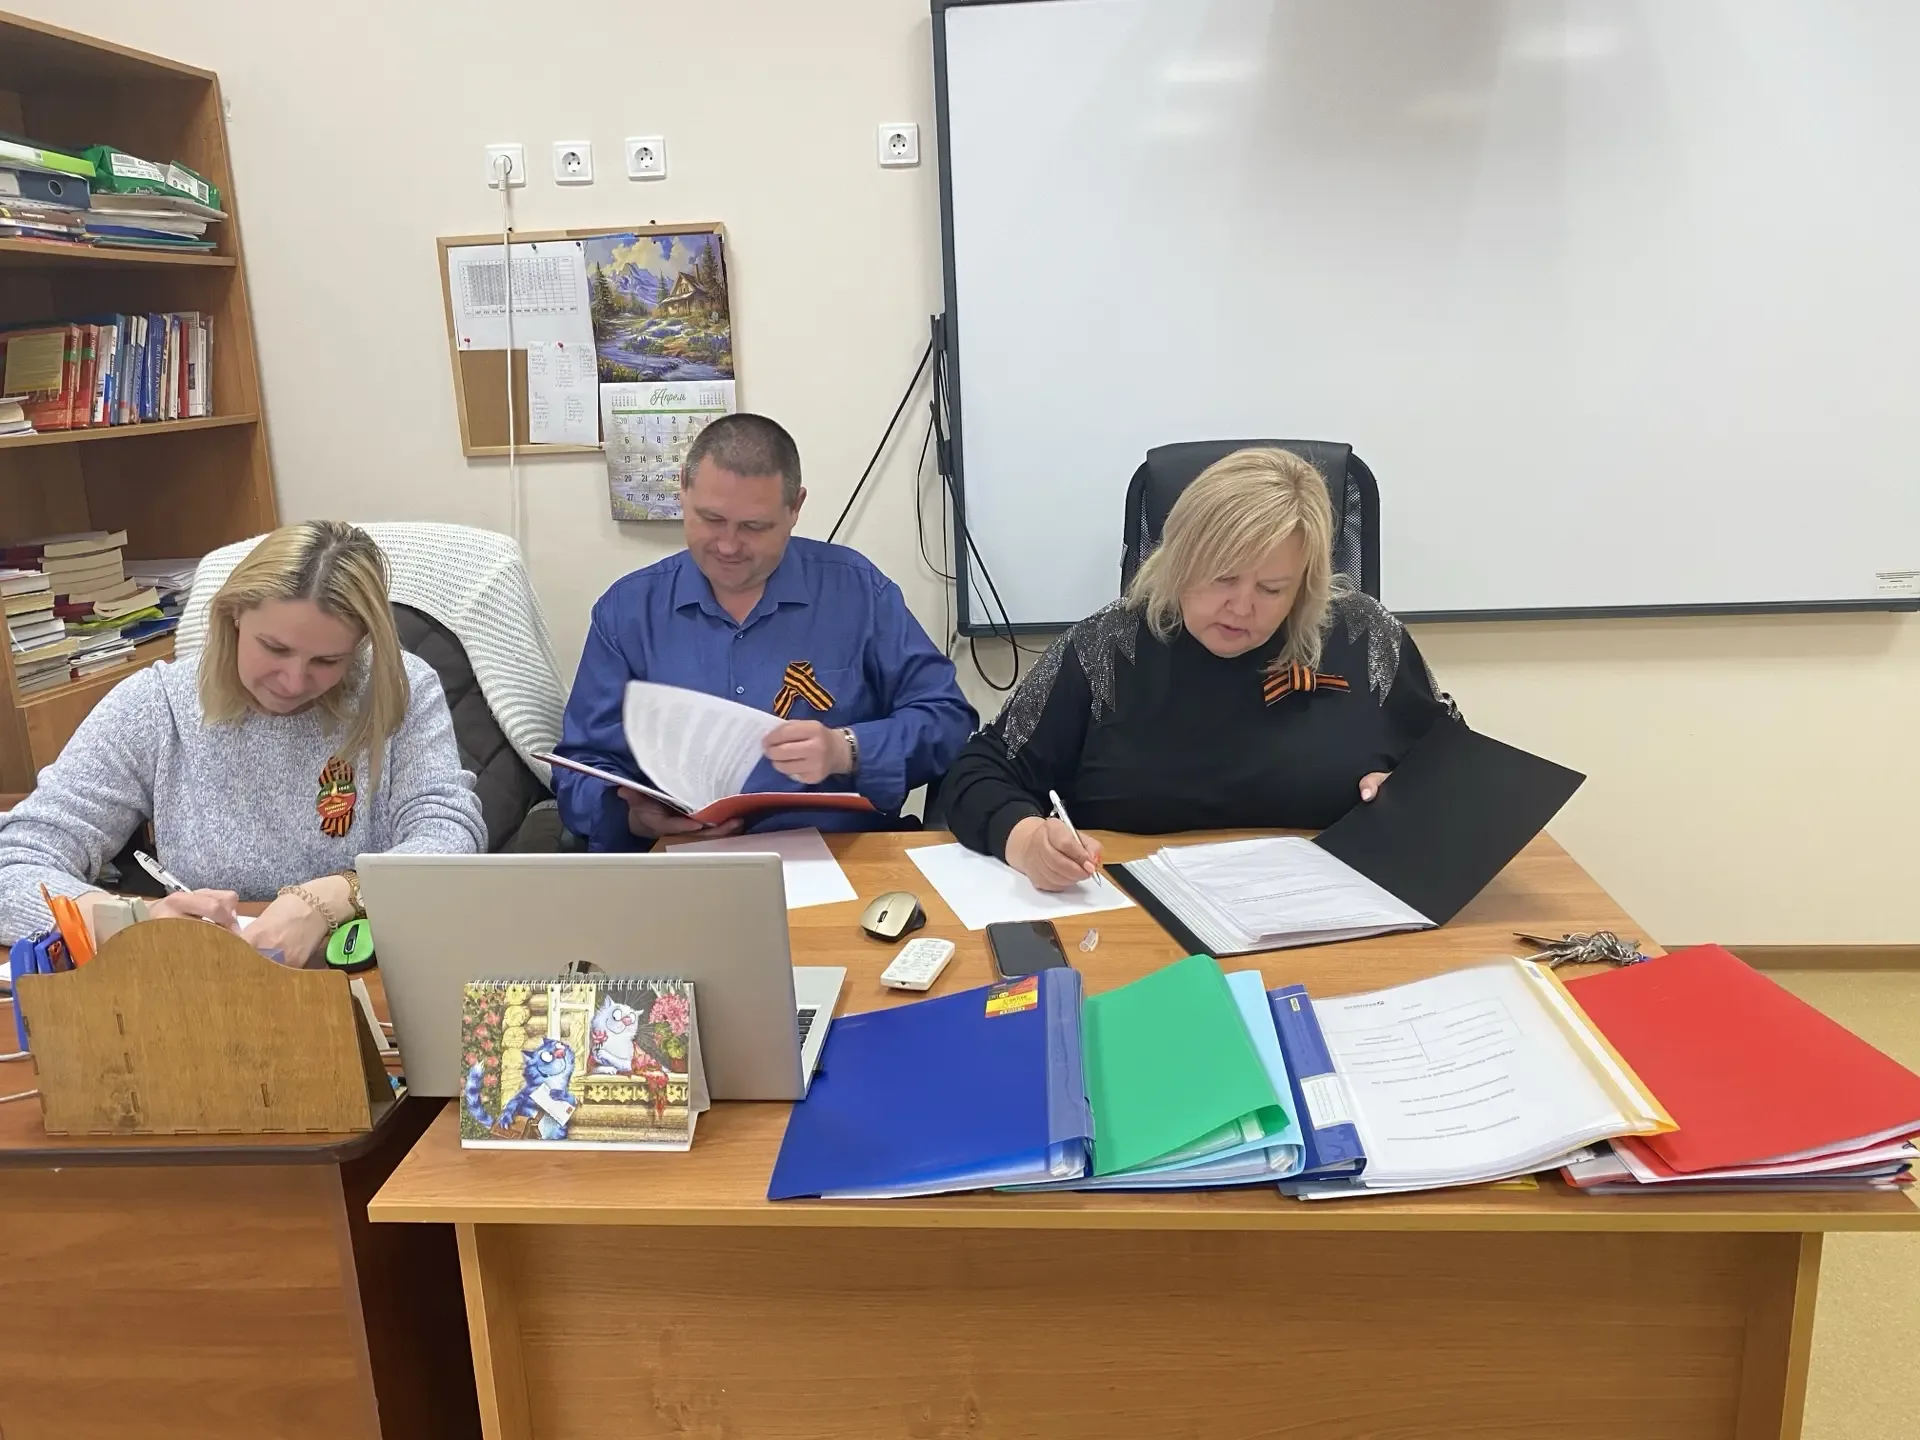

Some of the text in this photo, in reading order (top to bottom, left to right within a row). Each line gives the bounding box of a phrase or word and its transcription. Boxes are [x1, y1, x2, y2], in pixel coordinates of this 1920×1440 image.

[649, 388, 687, 407] Апрель
[656, 416, 660, 424] 1
[671, 416, 676, 424] 2
[624, 436, 630, 444] 6
[656, 435, 661, 443] 8
[673, 435, 678, 443] 9
[687, 435, 694, 443] 10
[655, 455, 663, 463] 15
[641, 474, 648, 482] 21
[655, 474, 664, 482] 22
[656, 493, 665, 501] 29
